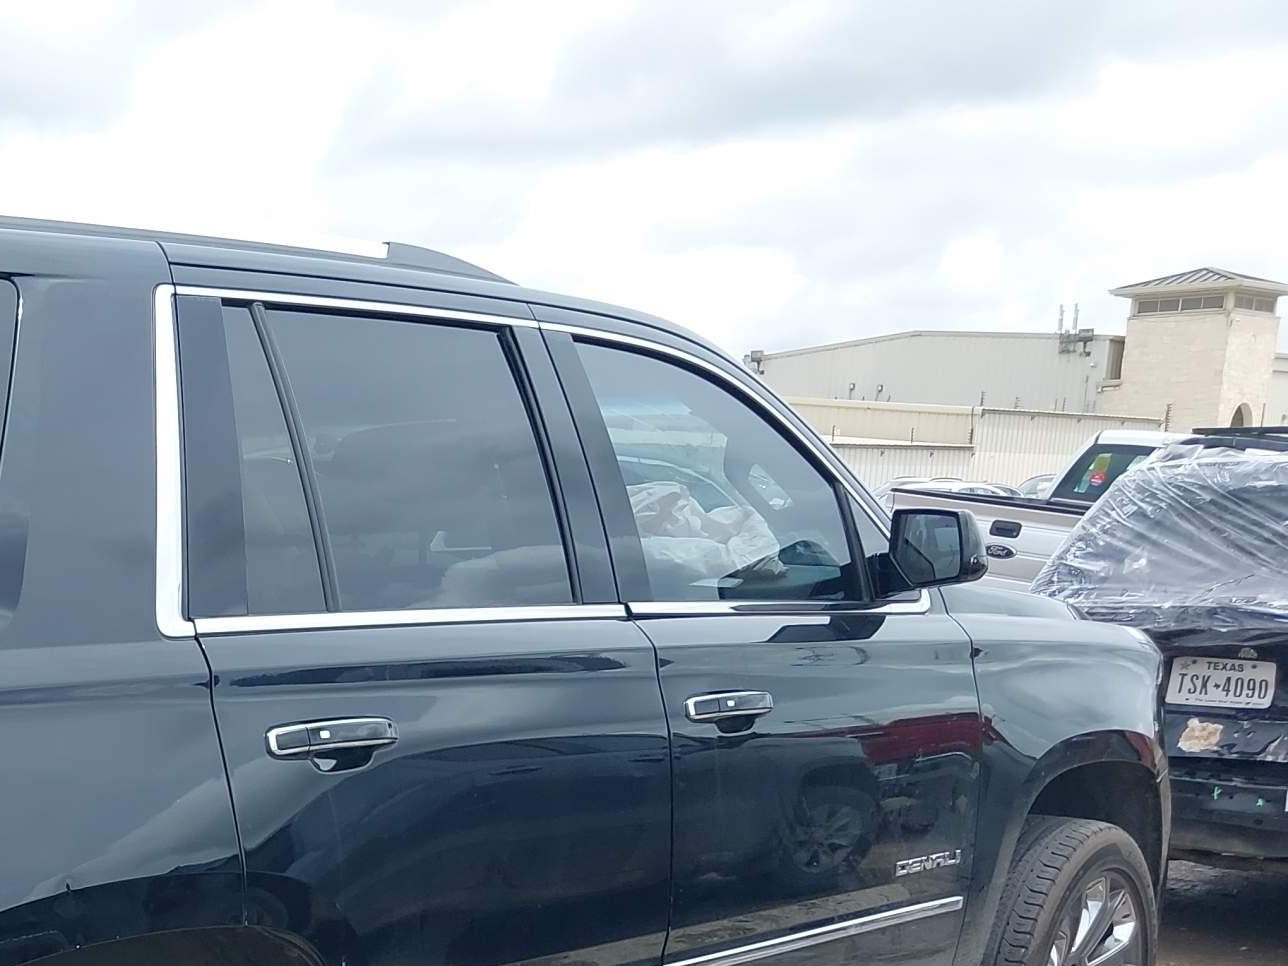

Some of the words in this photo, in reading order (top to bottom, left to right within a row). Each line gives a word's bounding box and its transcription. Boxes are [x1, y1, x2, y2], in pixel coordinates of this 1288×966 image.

[1206, 661, 1244, 673] TEXAS
[1177, 672, 1212, 695] TSK
[1222, 676, 1269, 699] 4090
[895, 849, 962, 877] DENALI
